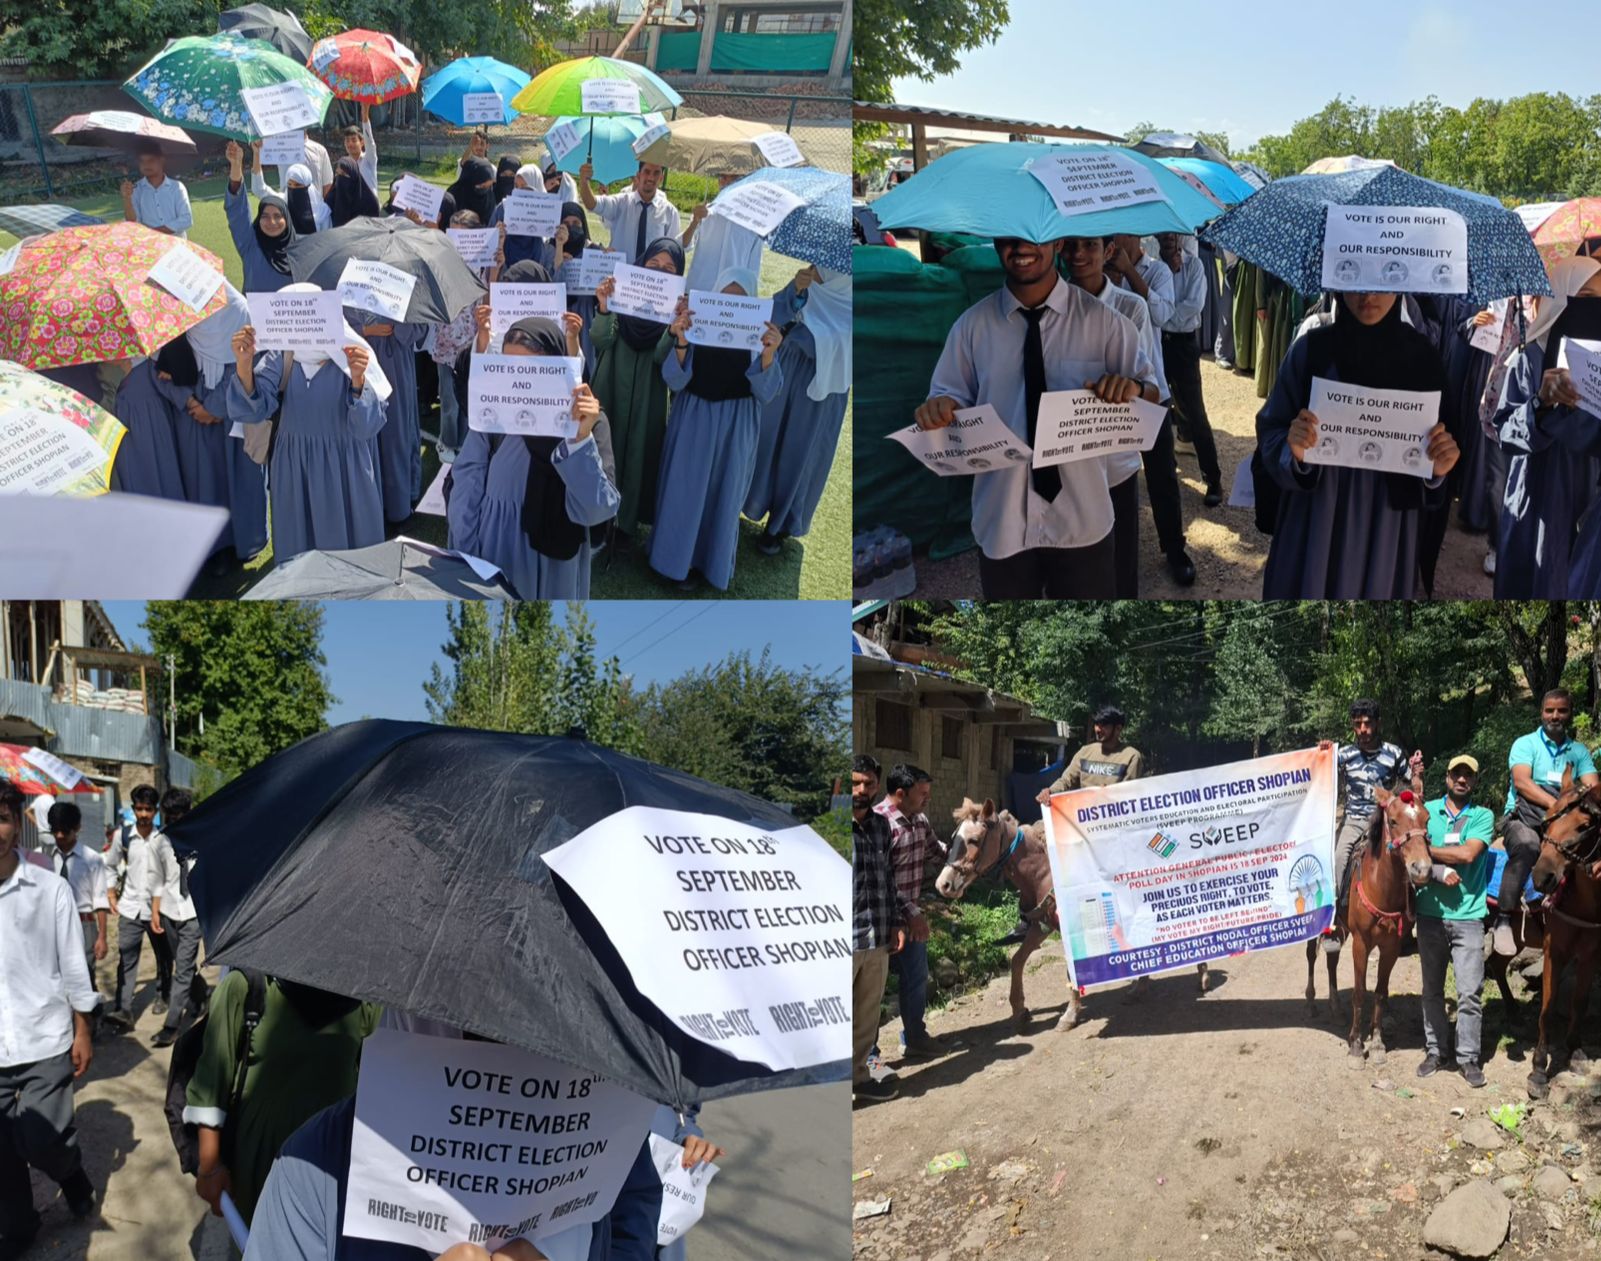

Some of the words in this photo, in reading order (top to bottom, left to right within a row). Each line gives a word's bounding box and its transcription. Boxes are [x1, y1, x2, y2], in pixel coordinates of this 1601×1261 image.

[1056, 157, 1080, 165] VOTE
[1082, 156, 1095, 164] ON
[1066, 162, 1118, 172] SEPTEMBER
[1061, 172, 1096, 184] DISTRICT
[1099, 169, 1134, 180] ELECTION
[1067, 182, 1100, 192] OFFICER
[1101, 178, 1136, 189] SHOPIAN
[1345, 214, 1373, 224] VOTE
[1375, 215, 1384, 224] IS
[1387, 215, 1411, 225] OUR
[1414, 216, 1448, 225] RIGHT
[1380, 231, 1404, 239] AND
[1339, 244, 1363, 254] OUR
[1366, 244, 1453, 258] RESPONSIBILITY
[376, 268, 389, 276] OUR
[630, 272, 644, 280] VOTE
[370, 276, 383, 284] AND
[630, 280, 664, 292] SEPTEMBER
[644, 289, 669, 300] ELECTION
[700, 298, 715, 306] VOTE
[725, 300, 740, 308] OUR
[741, 302, 761, 310] RIGHT
[265, 318, 294, 326] DISTRICT
[694, 318, 708, 326] OUR
[710, 320, 761, 332] RESPONSIBILITY
[483, 364, 505, 374] VOTE
[507, 365, 516, 374] IS
[517, 365, 537, 375] OUR
[540, 366, 568, 376] RIGHT
[512, 381, 532, 390] AND
[480, 394, 500, 404] OUR
[502, 395, 572, 406] RESPONSIBILITY
[1071, 396, 1097, 406] VOTE
[1327, 391, 1353, 405] VOTE
[1356, 397, 1365, 406] IS
[1367, 398, 1390, 409] OUR
[1392, 401, 1425, 412] RIGHT
[1074, 407, 1130, 416] SEPTEMBER
[1358, 414, 1382, 423] AND
[1059, 417, 1100, 428] DISTRICT
[1100, 416, 1140, 424] ELECTION
[1057, 428, 1093, 440] OFFICER
[1094, 425, 1134, 434] SHOPIAN
[1320, 423, 1343, 434] OUR
[1345, 425, 1425, 443] RESPONSIBILITY
[29, 431, 67, 453] ELECTION
[924, 452, 944, 461] OUR
[0, 462, 35, 488] OFFICER
[33, 444, 71, 468] SHOPIAN
[1088, 764, 1115, 776] NIKE
[1077, 799, 1137, 823] DISTRICT
[1140, 788, 1202, 812] ELECTION
[1203, 778, 1256, 801] OFFICER
[1257, 768, 1312, 791] SHOPIAN
[1086, 820, 1130, 833] SYSTEMATIC
[1132, 814, 1158, 825] VOTERS
[1160, 808, 1199, 820] EDUCATION
[1200, 806, 1215, 814] AND
[1216, 798, 1256, 810] ELECTORAL
[1257, 788, 1308, 803] PARTICIPATION
[643, 834, 711, 855] VOTE
[711, 837, 749, 855] ON
[1113, 866, 1167, 882] ATTENTION
[1129, 880, 1153, 890] POLL
[1156, 874, 1173, 885] DAY
[1176, 872, 1186, 880] IN
[1188, 865, 1228, 878] SHOPIAN
[1251, 857, 1268, 867] SEP
[676, 870, 802, 892] SEPTEMBER
[1143, 890, 1165, 903] JOIN
[1166, 886, 1182, 898] US
[1184, 883, 1198, 894] TO
[1200, 874, 1249, 890] EXERCISE
[1251, 868, 1279, 882] YOUR
[1233, 886, 1246, 896] TO
[663, 909, 751, 931] DISTRICT
[754, 904, 845, 928] ELECTION
[1156, 912, 1169, 922] AS
[1170, 907, 1195, 920] EACH
[1195, 902, 1226, 915] VOTER
[1172, 922, 1197, 930] VOTER
[1219, 912, 1238, 920] LEFT
[1167, 931, 1188, 939] VOTE
[1108, 947, 1162, 966] COURTESY
[1168, 934, 1214, 953] DISTRICT
[1216, 928, 1249, 942] NODAL
[1250, 921, 1290, 936] OFFICER
[1130, 957, 1163, 972] CHIEF
[1165, 944, 1225, 964] EDUCATION
[1226, 935, 1268, 950] OFFICER
[1270, 926, 1307, 942] SHOPIAN
[683, 946, 766, 972] OFFICER
[764, 937, 852, 965] SHOPIAN
[443, 1066, 512, 1096] VOTE
[520, 1077, 561, 1100] ON
[448, 1104, 591, 1136] SEPTEMBER
[410, 1134, 512, 1164] DISTRICT
[517, 1138, 608, 1167] ELECTION
[406, 1165, 499, 1196] OFFICER
[504, 1166, 589, 1197] SHOPIAN
[682, 1191, 697, 1205] OUR
